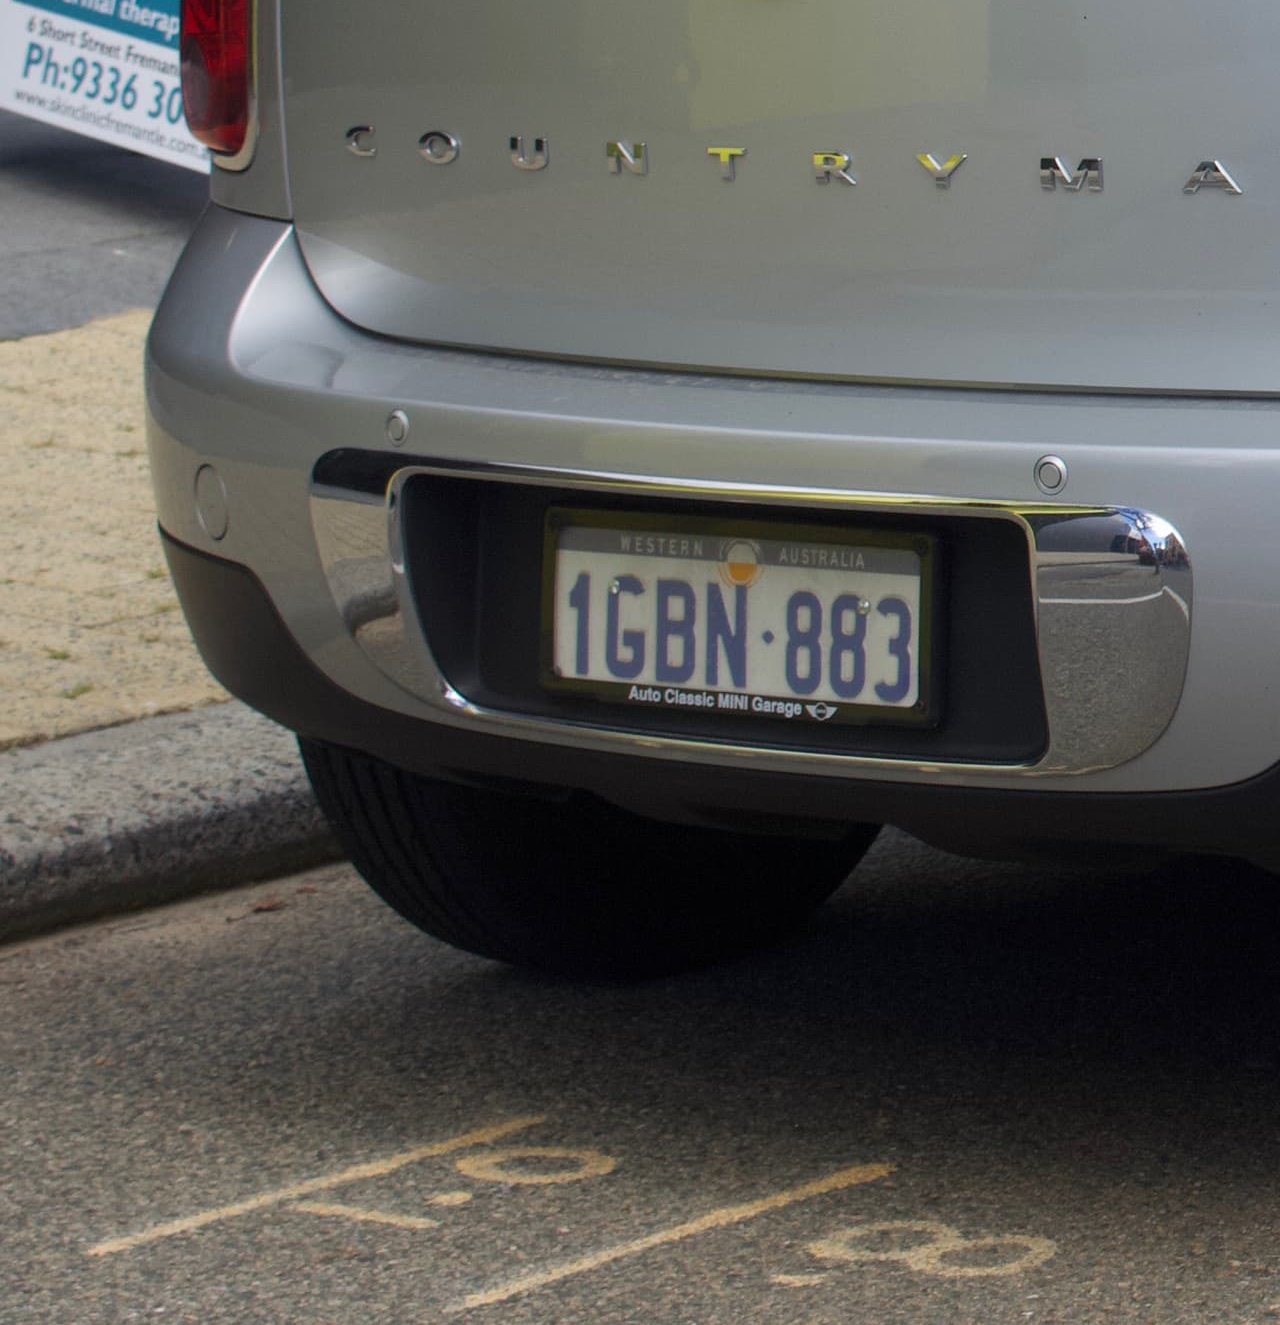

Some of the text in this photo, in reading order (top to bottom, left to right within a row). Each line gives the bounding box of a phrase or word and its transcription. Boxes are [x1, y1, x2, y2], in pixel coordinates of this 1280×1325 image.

[26, 16, 35, 34] 6
[39, 19, 76, 47] Short
[80, 30, 121, 58] Street
[620, 535, 866, 568] WESTERN AUSTRALIA
[628, 685, 662, 704] Auto
[664, 687, 715, 708] Classic
[717, 693, 749, 712] MINI
[752, 696, 803, 719] Garage
